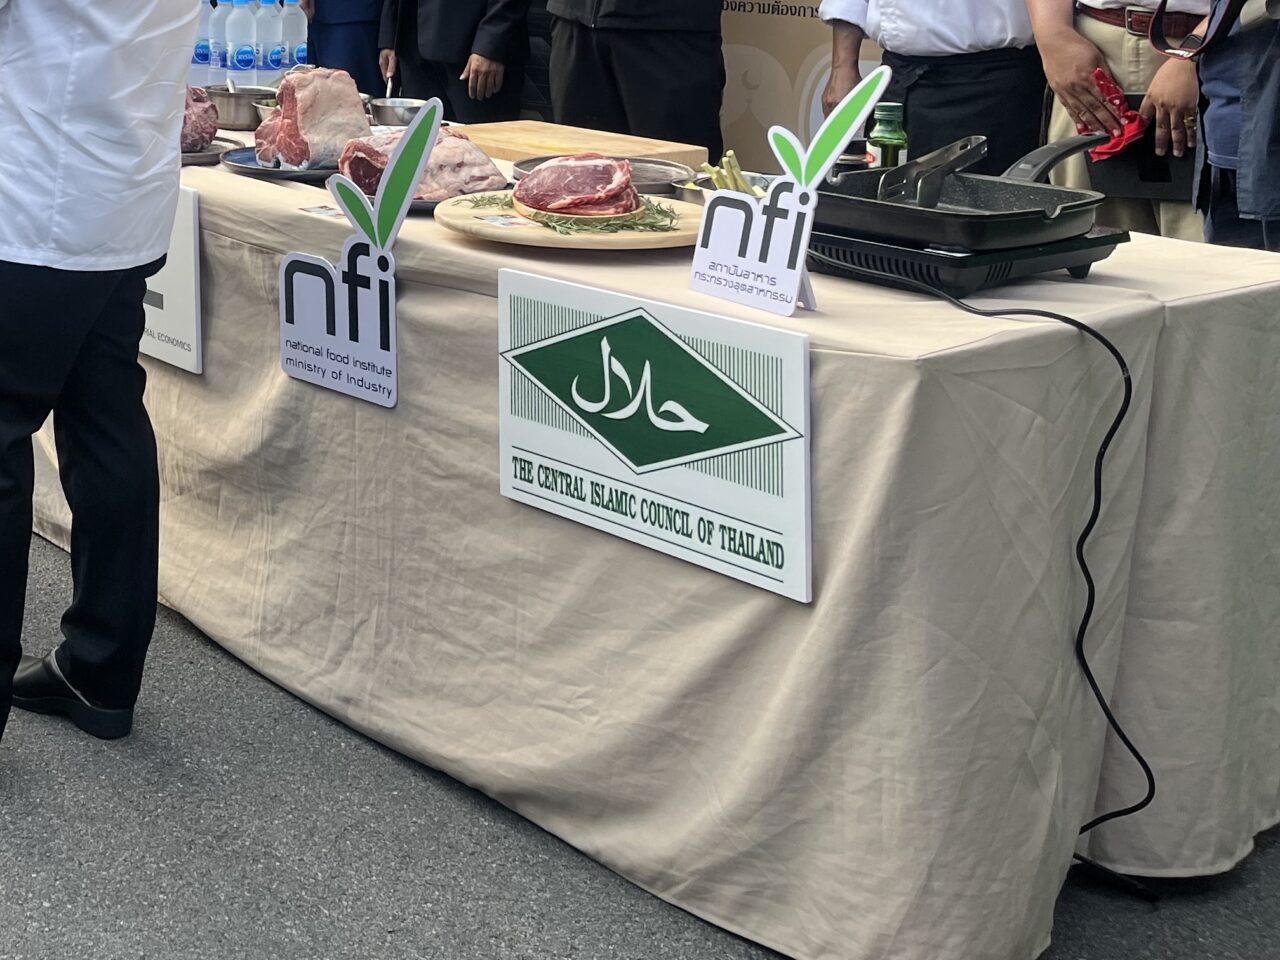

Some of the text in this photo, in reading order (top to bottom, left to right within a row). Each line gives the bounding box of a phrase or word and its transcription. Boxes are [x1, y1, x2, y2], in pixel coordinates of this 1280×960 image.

[700, 181, 810, 271] nfi
[157, 331, 192, 353] ECONOMICS
[284, 242, 390, 353] nfi
[285, 339, 324, 358] national
[326, 348, 350, 366] food
[285, 356, 326, 379] ministry
[331, 368, 343, 381] of
[572, 336, 710, 434] حلال
[512, 455, 785, 570] THE CENTRAL ISLAMIC COUNCIL OF THAILAND
